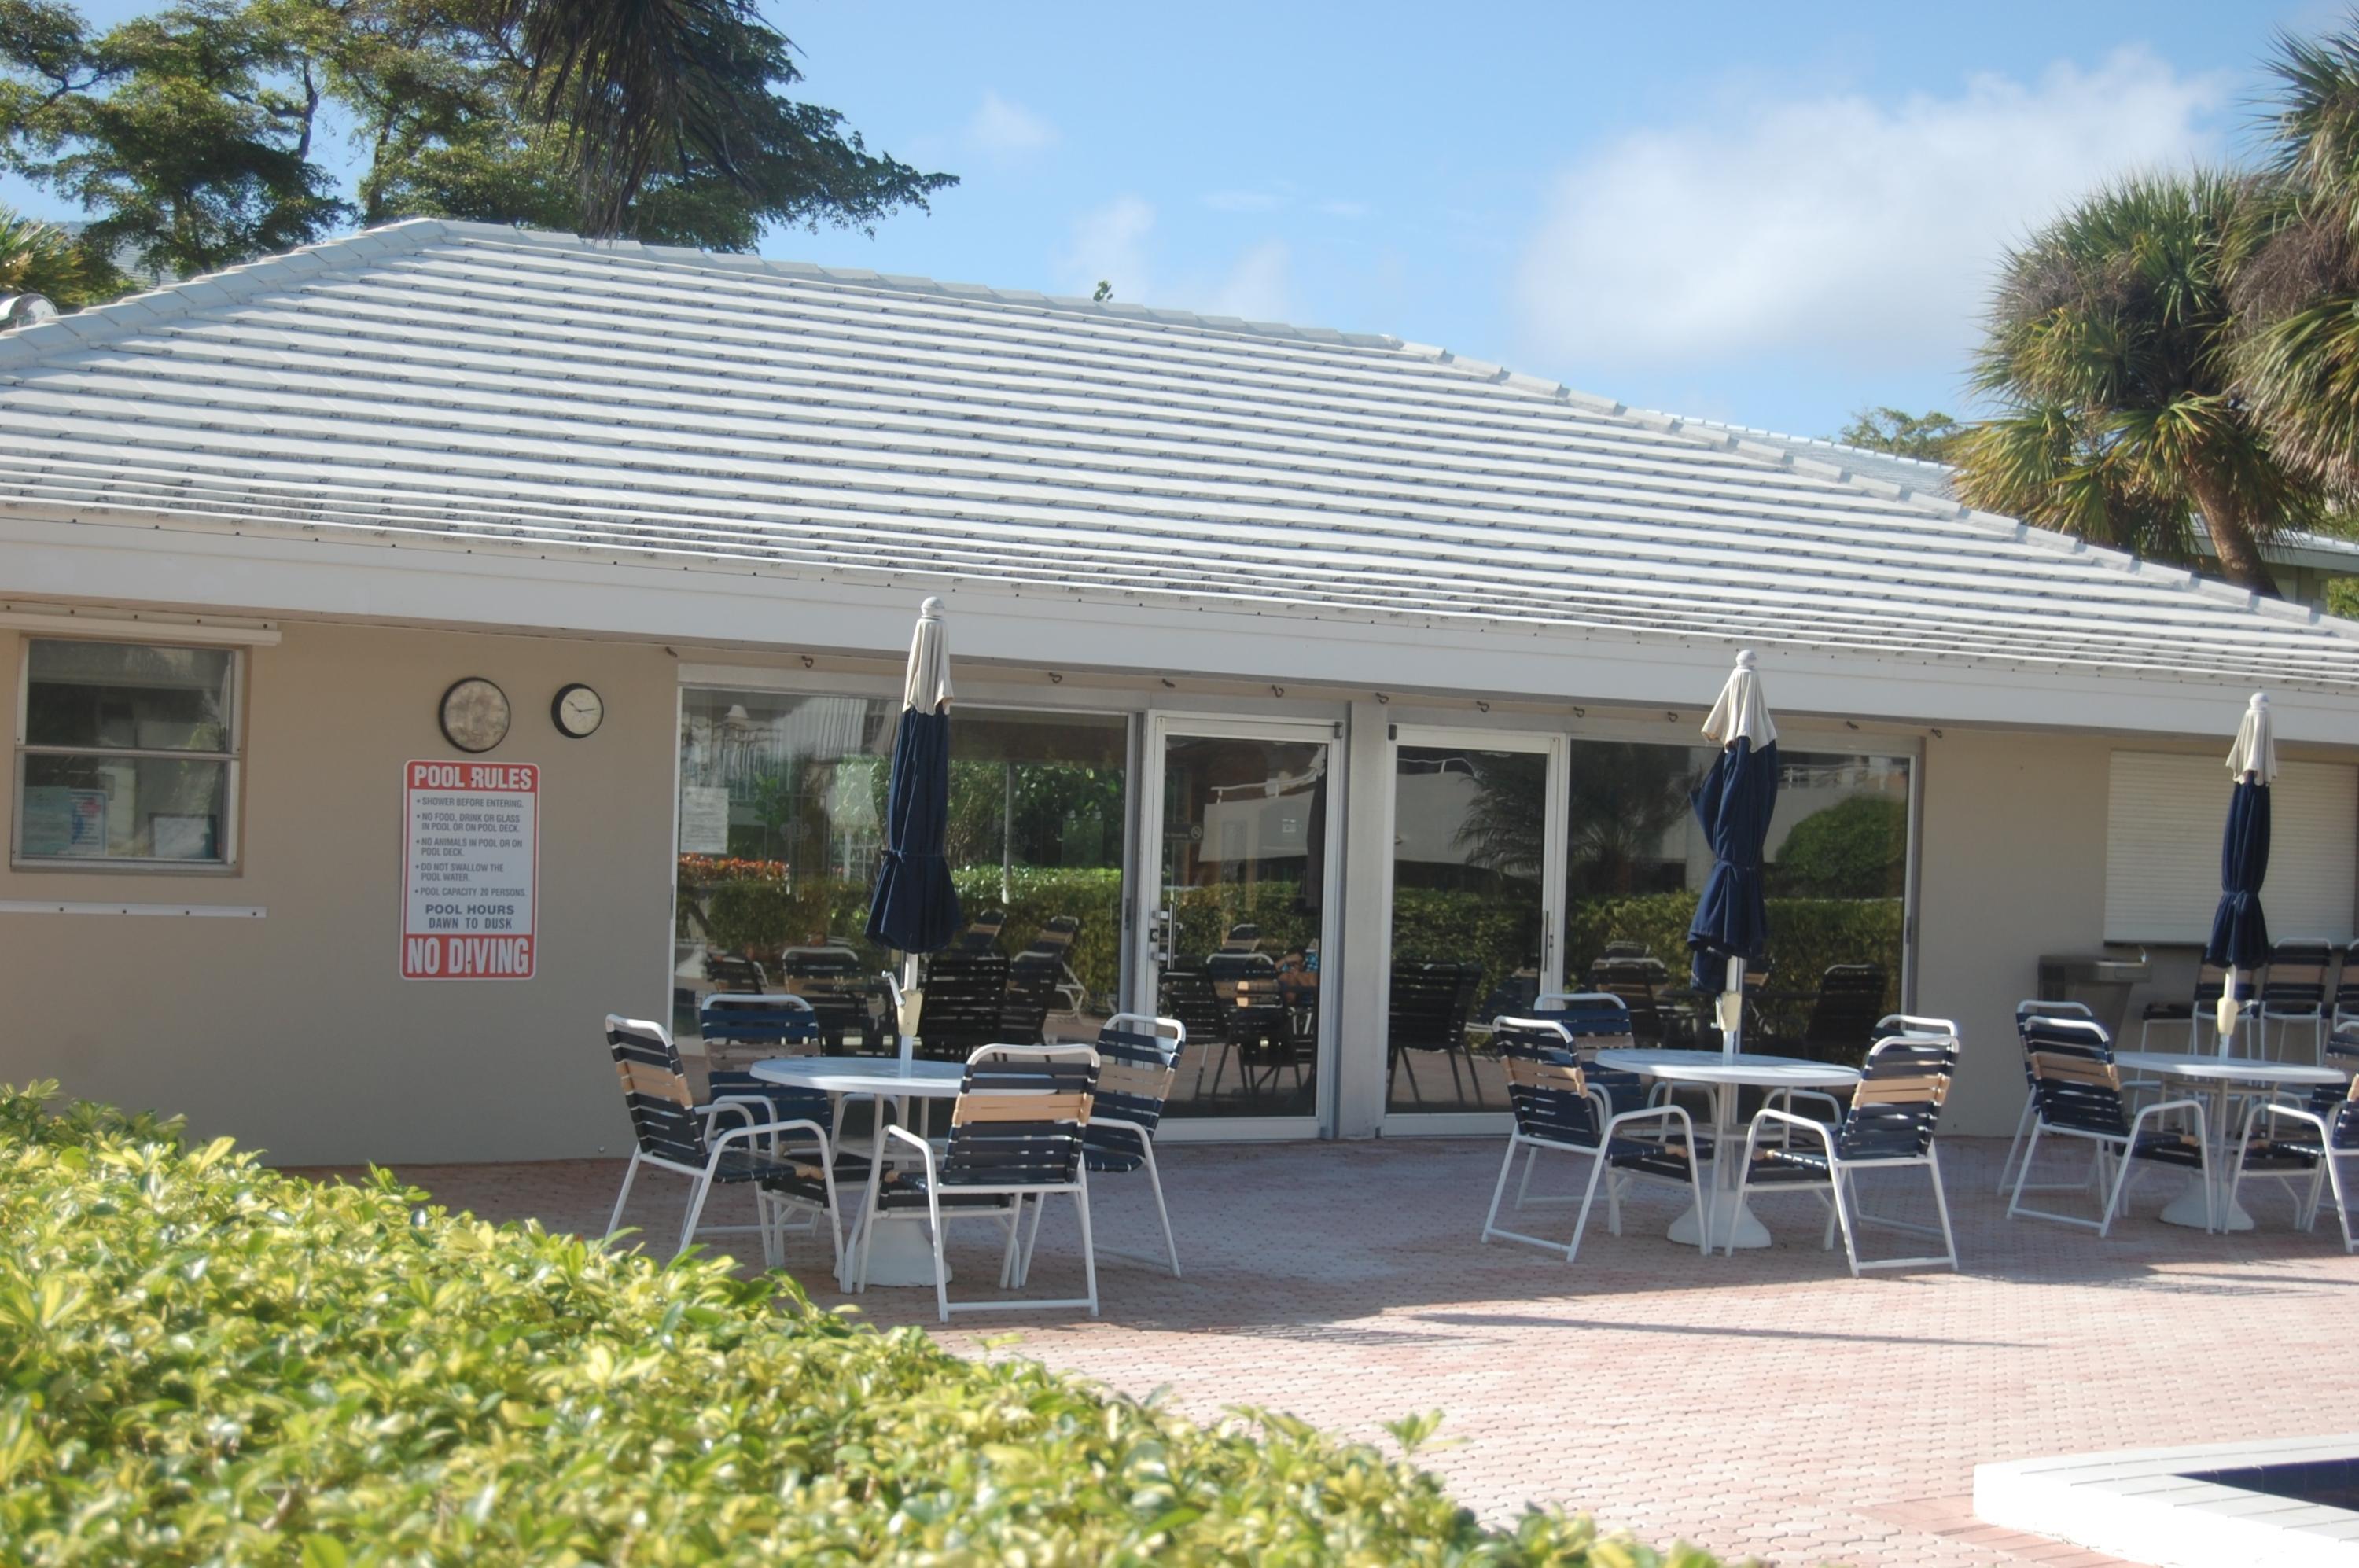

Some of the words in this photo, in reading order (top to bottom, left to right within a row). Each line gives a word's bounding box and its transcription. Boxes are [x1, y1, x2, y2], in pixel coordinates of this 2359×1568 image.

[414, 765, 466, 788] POOL
[471, 767, 532, 790] RULES
[421, 797, 455, 806] SHOWER
[456, 797, 484, 807] BEFORE
[421, 812, 433, 821] NO
[459, 813, 482, 823] DRINK
[484, 814, 495, 823] OR
[496, 815, 521, 823] GLASS
[421, 823, 430, 831] IN
[431, 823, 451, 832] POOL
[453, 823, 464, 832] OR
[465, 823, 477, 832] ON
[477, 823, 498, 833] POOL
[421, 837, 433, 846] NO
[433, 837, 467, 847] ANIMALS
[469, 838, 477, 847] IN
[478, 838, 498, 848] POOL
[499, 839, 510, 848] OR
[511, 839, 523, 848] ON
[421, 848, 441, 856] POOL
[421, 862, 432, 871] DO
[433, 863, 449, 871] NOT
[450, 863, 488, 872] SWALLOW
[490, 863, 504, 873] THE
[421, 873, 442, 882] POOL
[420, 886, 440, 896] POOL
[442, 887, 478, 896] CAPACITY
[425, 904, 462, 915] POOL
[467, 904, 515, 915] HOURS
[429, 917, 458, 929] DAWN
[466, 917, 479, 929] TO
[484, 918, 513, 929] DUSK
[407, 937, 441, 974] NO
[448, 937, 529, 974] DIVING
